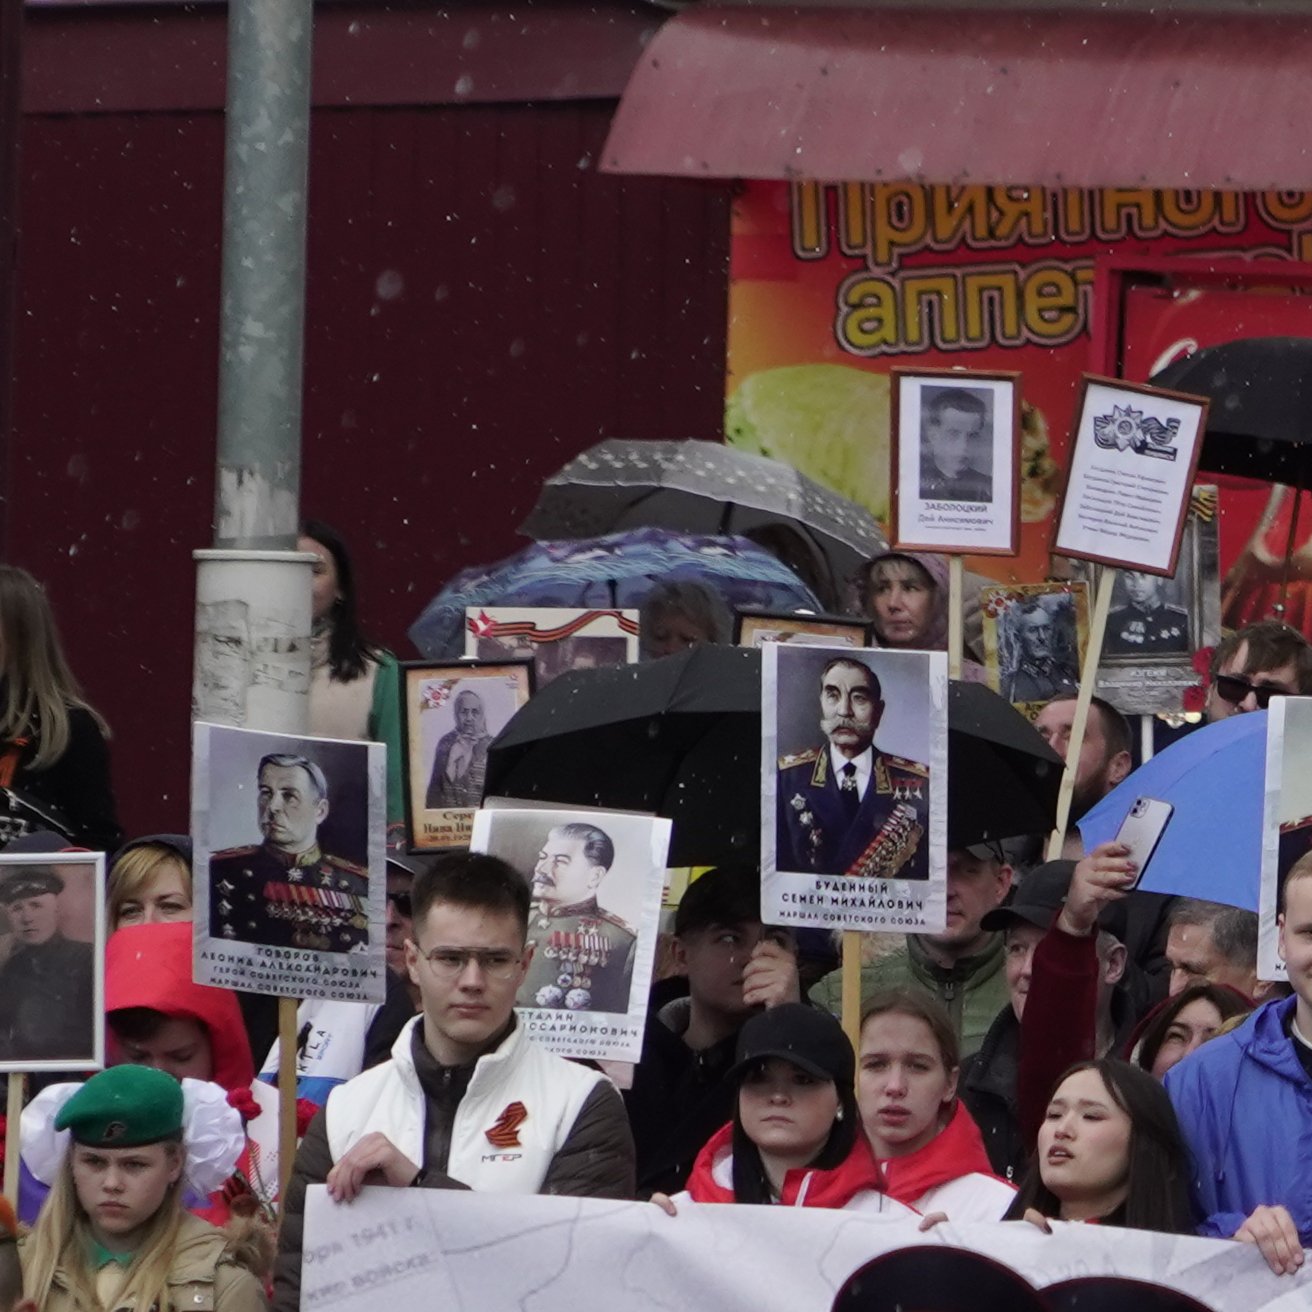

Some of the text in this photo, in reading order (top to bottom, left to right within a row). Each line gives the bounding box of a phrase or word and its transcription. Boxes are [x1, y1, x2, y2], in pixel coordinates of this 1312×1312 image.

[815, 880, 888, 894] БУДЕННЫЙ
[781, 892, 923, 911] СЕМЕН МИХАЙЛОВИЧ
[779, 911, 926, 926] МАРШАЛ СОВЕТСКОГО СОЮЗА
[257, 947, 320, 963] ГОВОРОВ
[201, 951, 377, 978] ЛЕОНИД АЛЕКСАНДРОВИЧ
[213, 966, 246, 976] ГЕРОЙ
[250, 971, 318, 985] СОВЕТСКОГО
[210, 977, 368, 1000] МАРШАЛ СОВЕТСКОГО СОЮЗА
[539, 1036, 596, 1045] СОВЕТСКОГО
